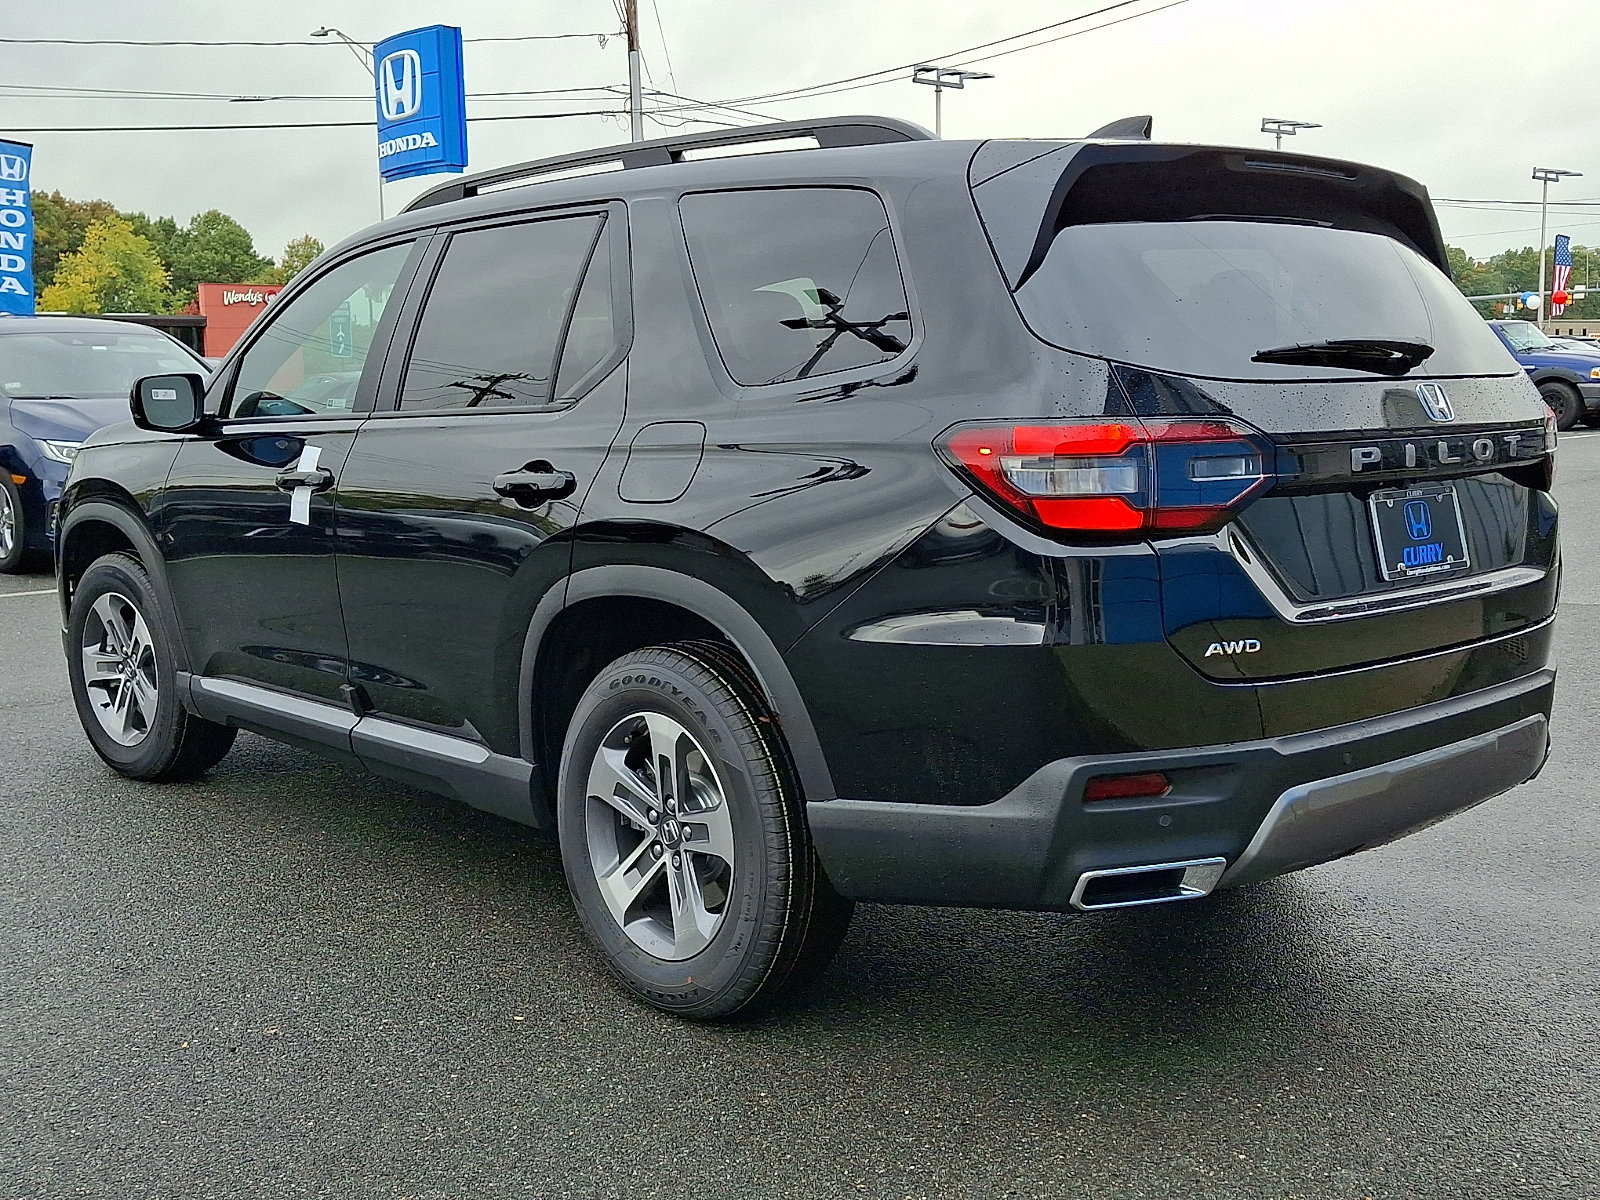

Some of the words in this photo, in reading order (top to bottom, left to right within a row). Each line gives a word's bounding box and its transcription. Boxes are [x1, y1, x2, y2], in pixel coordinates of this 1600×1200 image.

[379, 131, 439, 158] HONDA
[223, 288, 263, 306] Wendy's
[1351, 435, 1522, 472] PILOT
[1406, 489, 1424, 497] CURRY
[1403, 542, 1444, 567] CURRY
[1204, 639, 1261, 658] AWD
[608, 674, 722, 744] GOODYEAR
